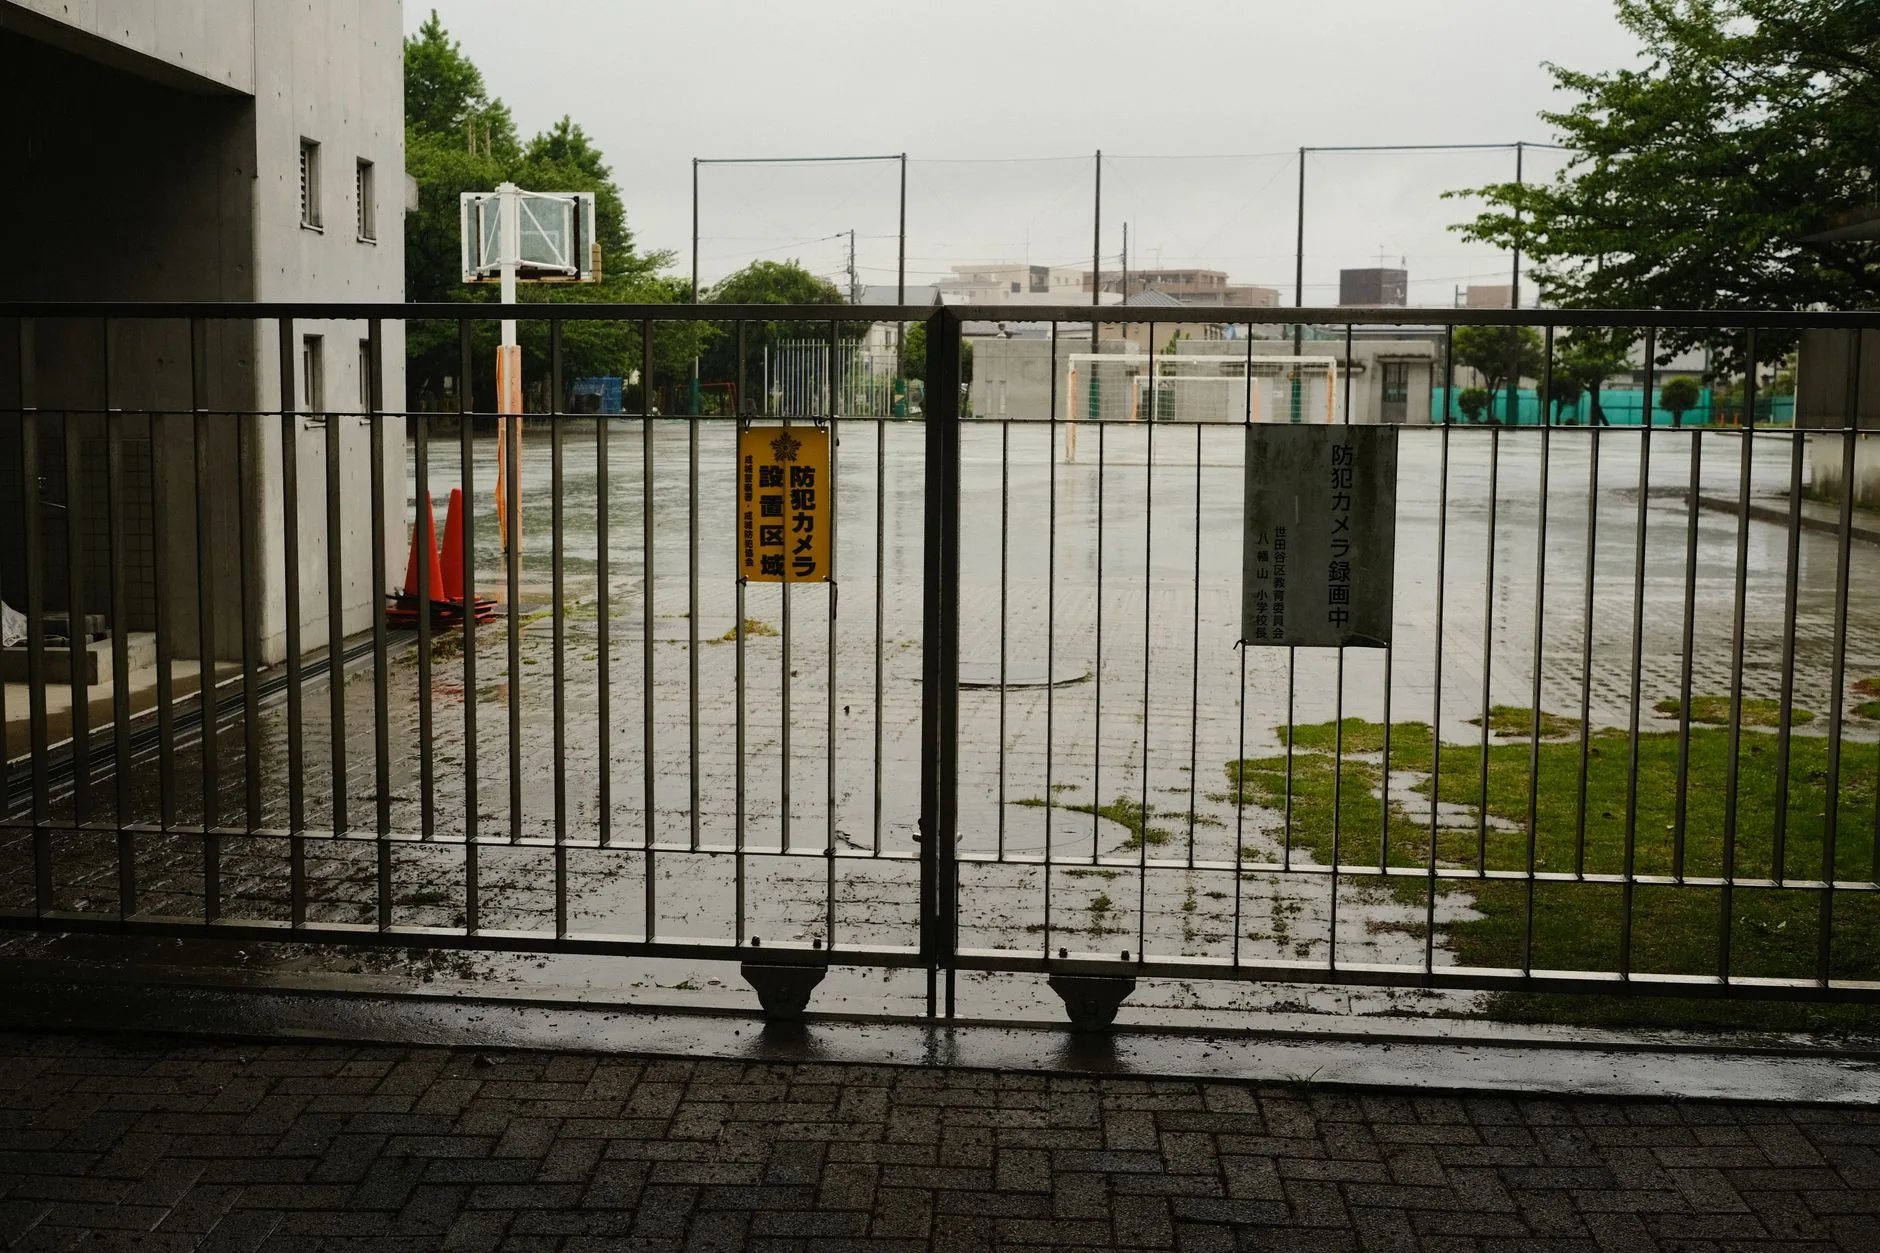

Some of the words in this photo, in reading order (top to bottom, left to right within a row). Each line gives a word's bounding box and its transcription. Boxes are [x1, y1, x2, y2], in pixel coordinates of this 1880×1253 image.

[759, 465, 785, 577] 設置区域
[790, 466, 816, 577] 防犯カメラ
[1328, 444, 1354, 629] 防犯カメラ録画中
[1272, 525, 1287, 640] 世田谷区教育委員会
